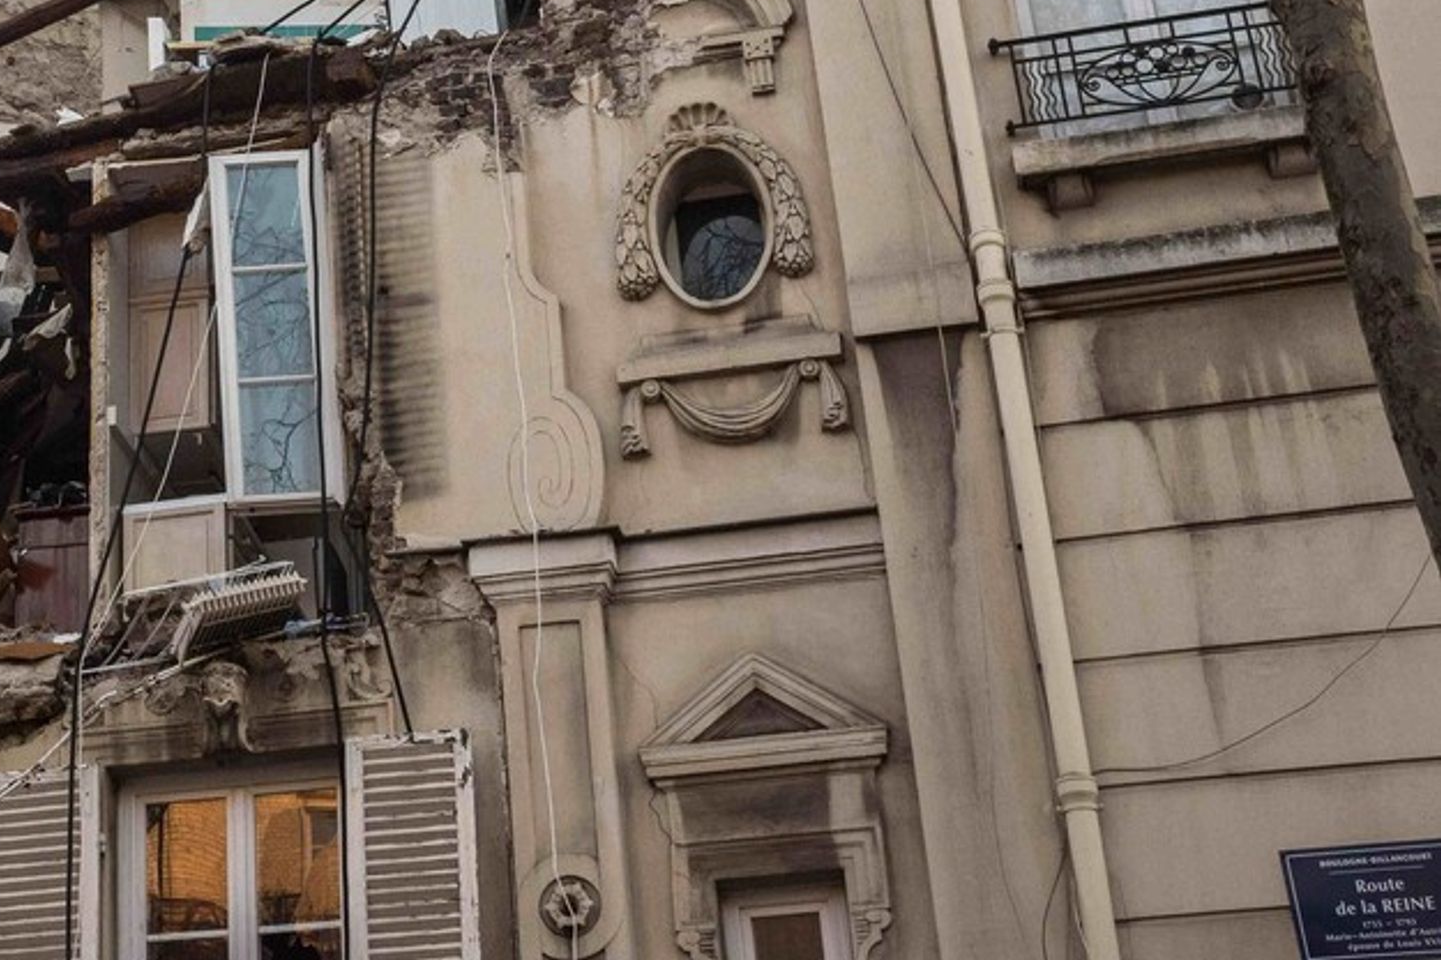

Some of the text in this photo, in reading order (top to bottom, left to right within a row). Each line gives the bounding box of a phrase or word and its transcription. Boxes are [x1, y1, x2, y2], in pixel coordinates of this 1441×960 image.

[1355, 878, 1405, 893] Route
[1335, 895, 1436, 916] de la REINE
